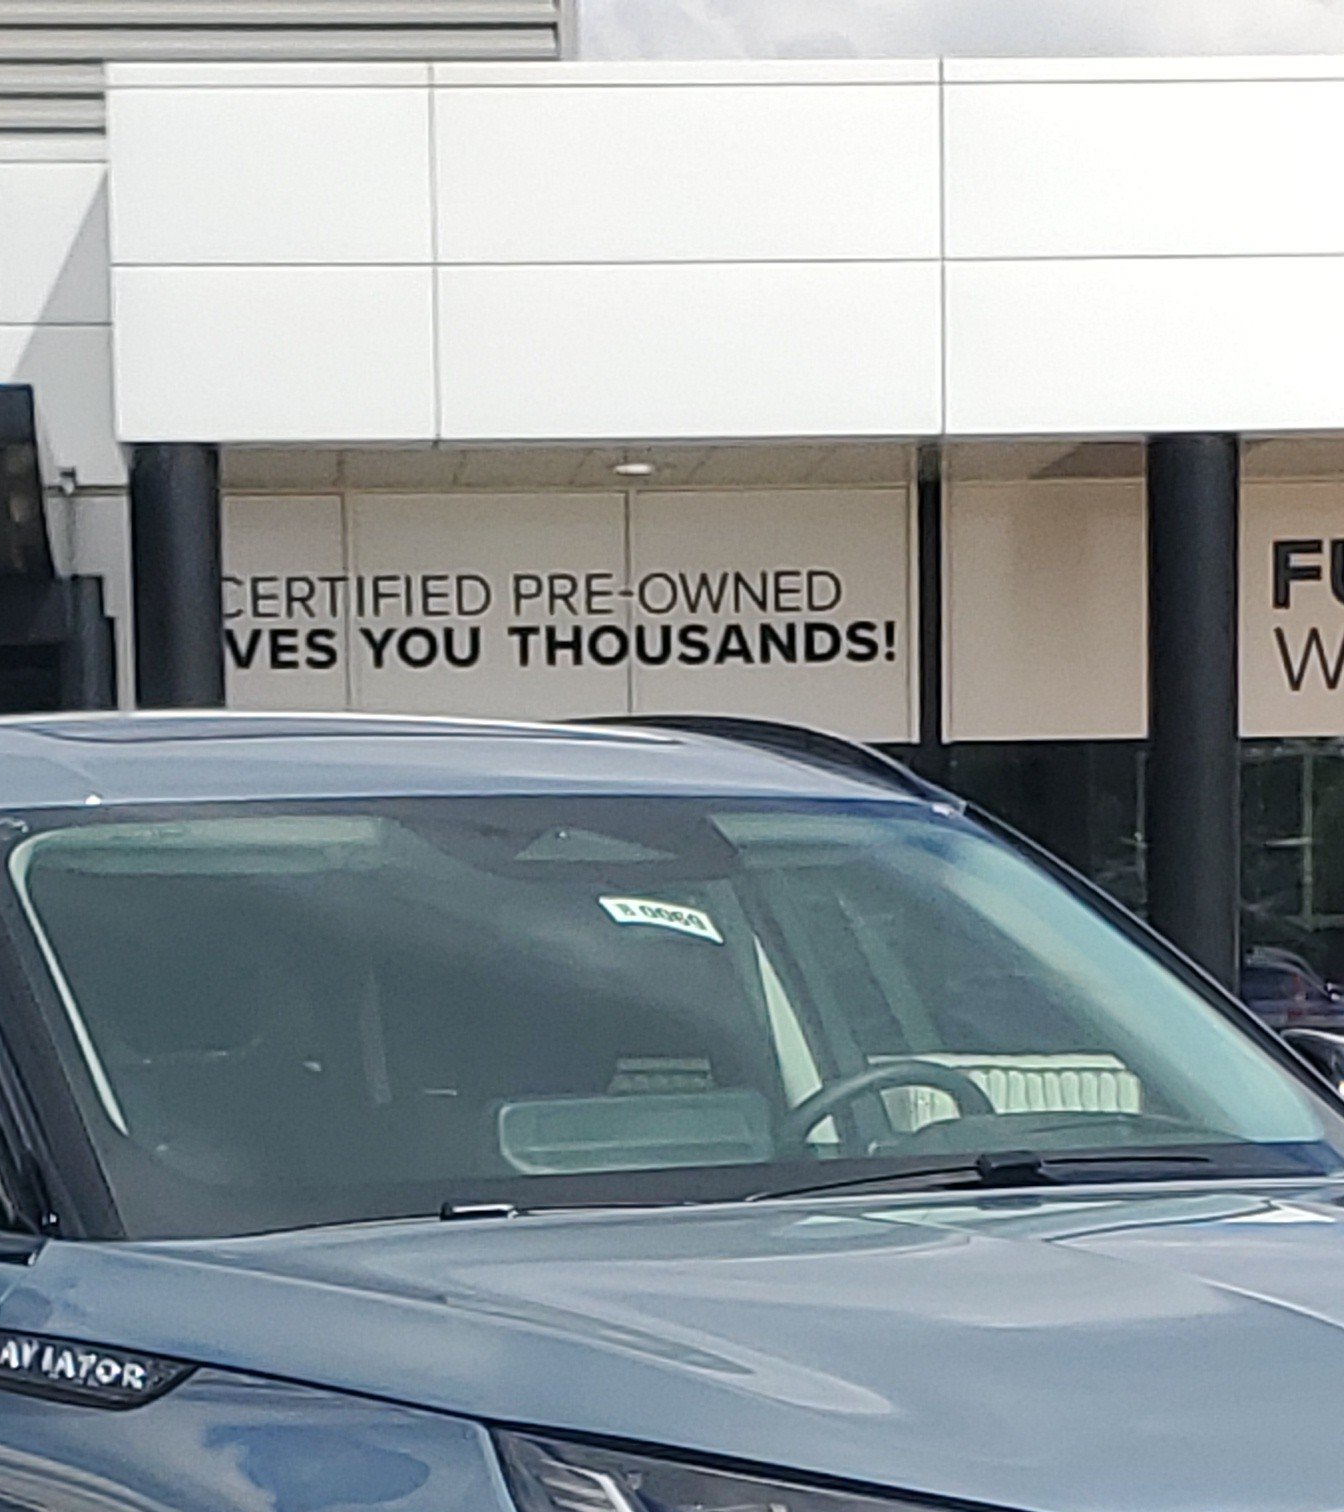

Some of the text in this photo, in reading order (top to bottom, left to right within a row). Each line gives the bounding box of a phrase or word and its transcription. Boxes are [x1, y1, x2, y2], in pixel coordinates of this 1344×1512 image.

[513, 571, 843, 615] PRE-OWNED
[362, 627, 481, 667] YOU
[508, 621, 897, 666] THOUSANDS!
